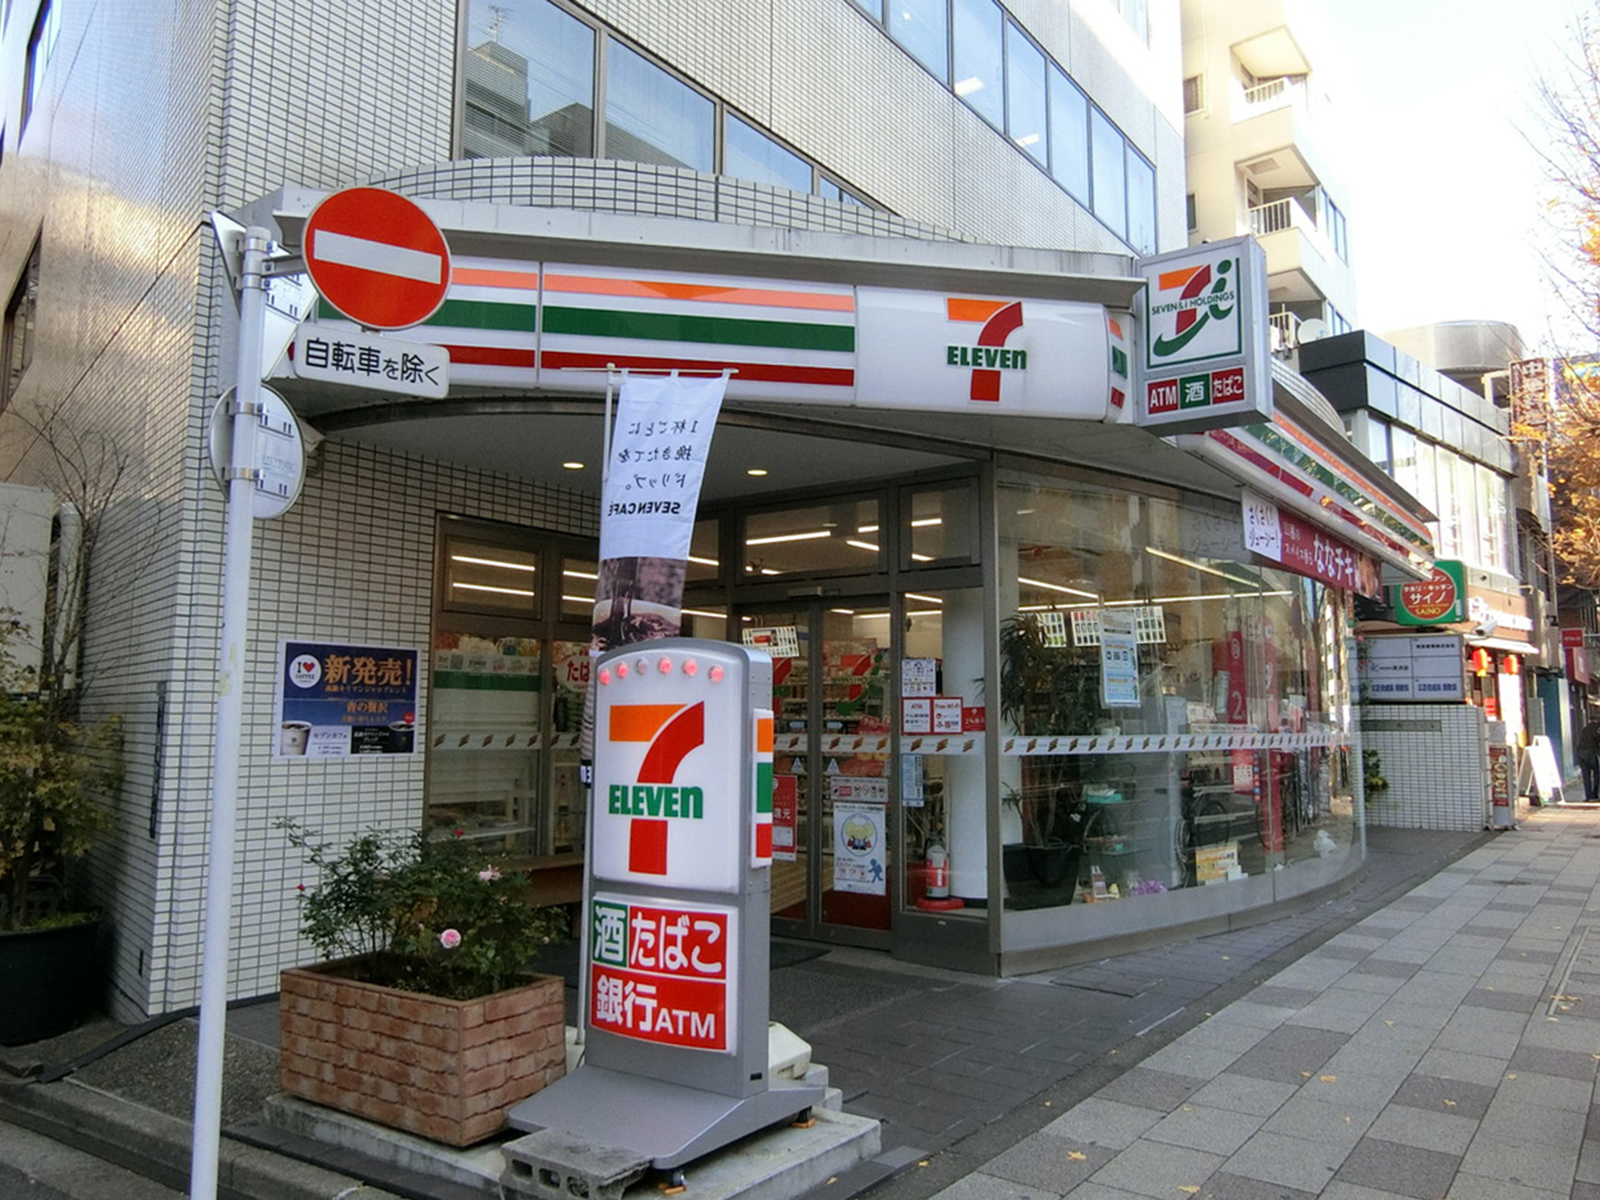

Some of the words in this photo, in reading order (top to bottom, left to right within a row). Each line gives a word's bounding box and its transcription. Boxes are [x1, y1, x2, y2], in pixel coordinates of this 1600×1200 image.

[1189, 290, 1235, 308] HOLDINGS
[305, 337, 440, 387] 自転車を除く
[1150, 385, 1177, 409] ATM
[1185, 381, 1205, 403] 酒
[1213, 375, 1243, 398] たばこ
[1313, 533, 1355, 587] ななチキ
[1409, 591, 1446, 605] サイノ
[1414, 607, 1441, 616] SAINO
[324, 654, 413, 686] 新発売!
[594, 904, 626, 962] 酒
[631, 911, 722, 973] たばこ
[596, 974, 715, 1039] 銀行ATM
